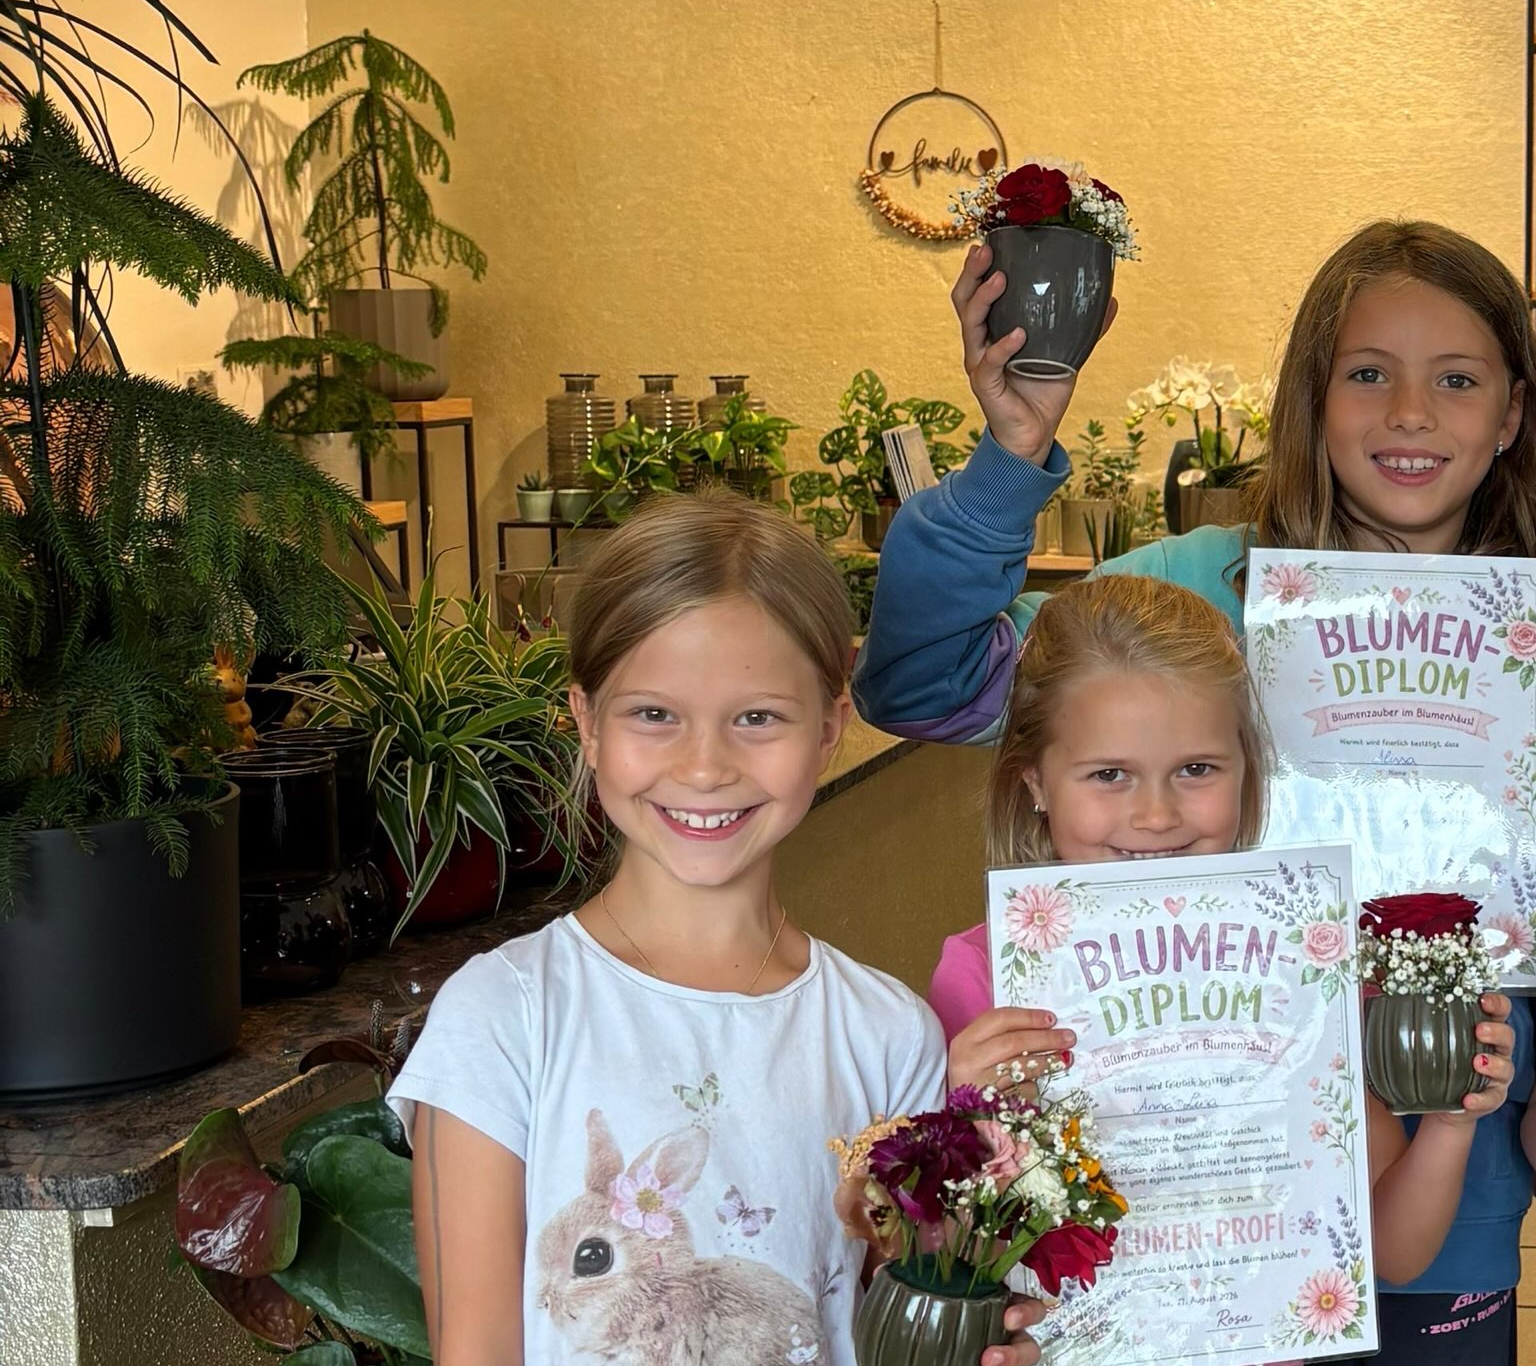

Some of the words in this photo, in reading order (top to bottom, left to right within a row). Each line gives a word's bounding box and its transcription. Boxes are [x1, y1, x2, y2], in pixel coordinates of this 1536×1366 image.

[1315, 611, 1500, 663] BLUMEN-
[1332, 658, 1470, 699] DIPLOM
[1331, 708, 1399, 722] Blumenzauber
[1402, 708, 1414, 717] im
[1074, 922, 1297, 993] BLUMEN-
[1099, 980, 1262, 1036] DIPLOM
[1102, 1042, 1182, 1068] Blumenzauber
[1185, 1041, 1199, 1051] im
[1114, 1085, 1143, 1094] Hiermit
[1146, 1081, 1162, 1091] wird
[1135, 1203, 1160, 1213] Dafür
[1237, 1195, 1253, 1203] zum
[1112, 1212, 1285, 1259] LUMEN-PROFI
[1216, 1309, 1253, 1328] Rosa
[1429, 1317, 1470, 1334] ZOEY
